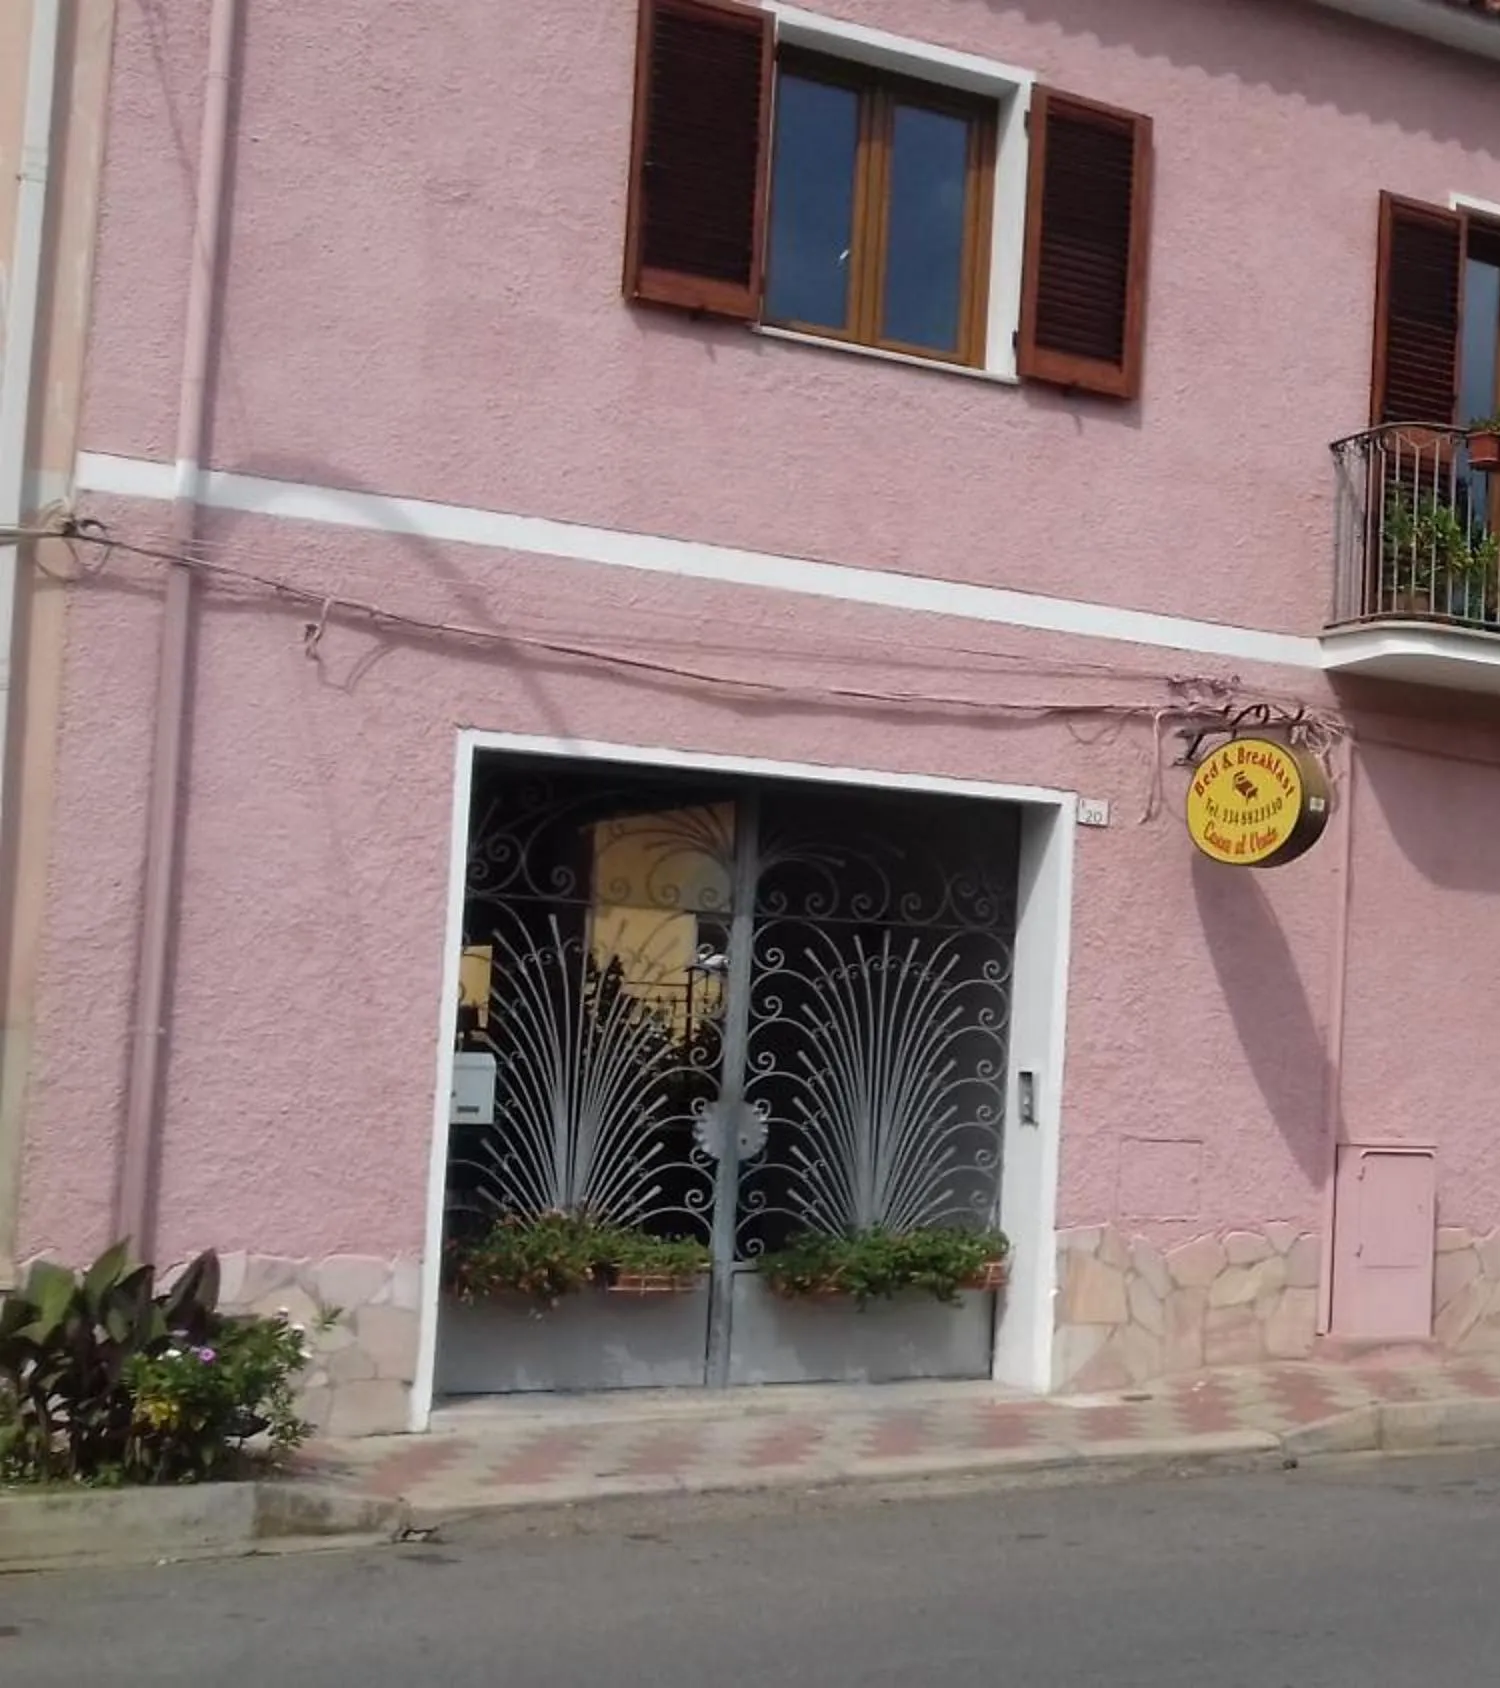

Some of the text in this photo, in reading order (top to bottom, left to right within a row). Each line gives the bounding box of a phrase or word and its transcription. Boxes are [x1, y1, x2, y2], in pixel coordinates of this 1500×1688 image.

[1194, 746, 1295, 798] Bed & Breakfast
